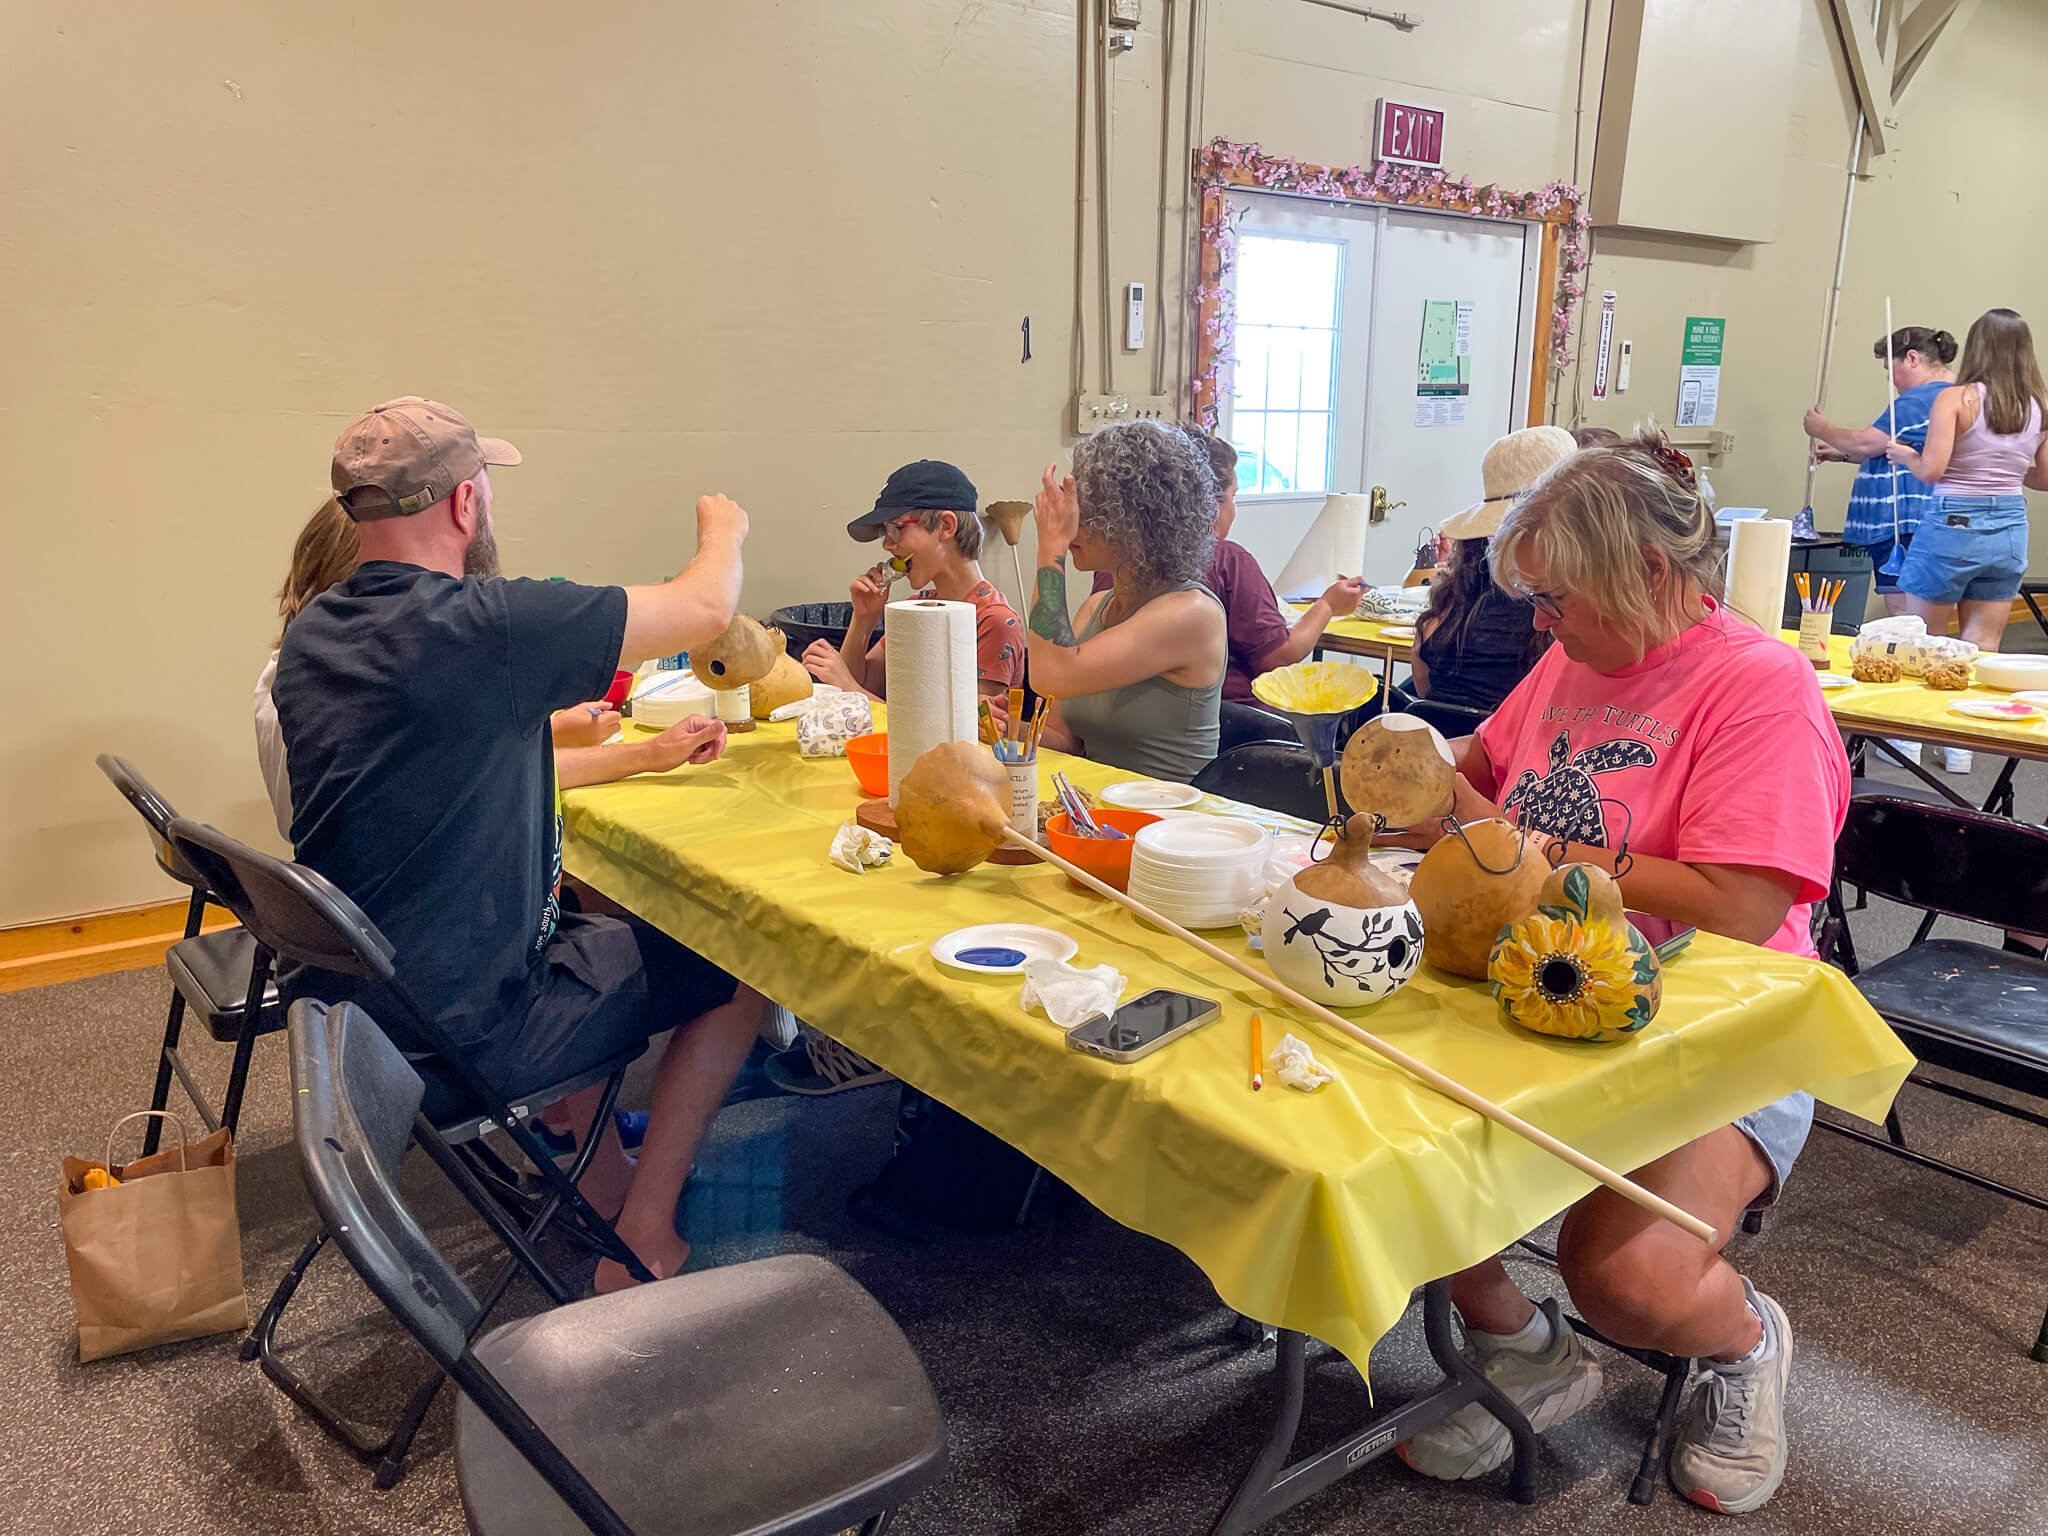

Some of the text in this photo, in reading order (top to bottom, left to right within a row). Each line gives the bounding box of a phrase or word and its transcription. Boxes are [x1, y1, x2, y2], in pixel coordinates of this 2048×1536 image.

[1391, 109, 1435, 161] EXIT
[1021, 315, 1032, 363] 1
[1572, 706, 1597, 723] TH
[1352, 1431, 1394, 1462] LIFETIME
